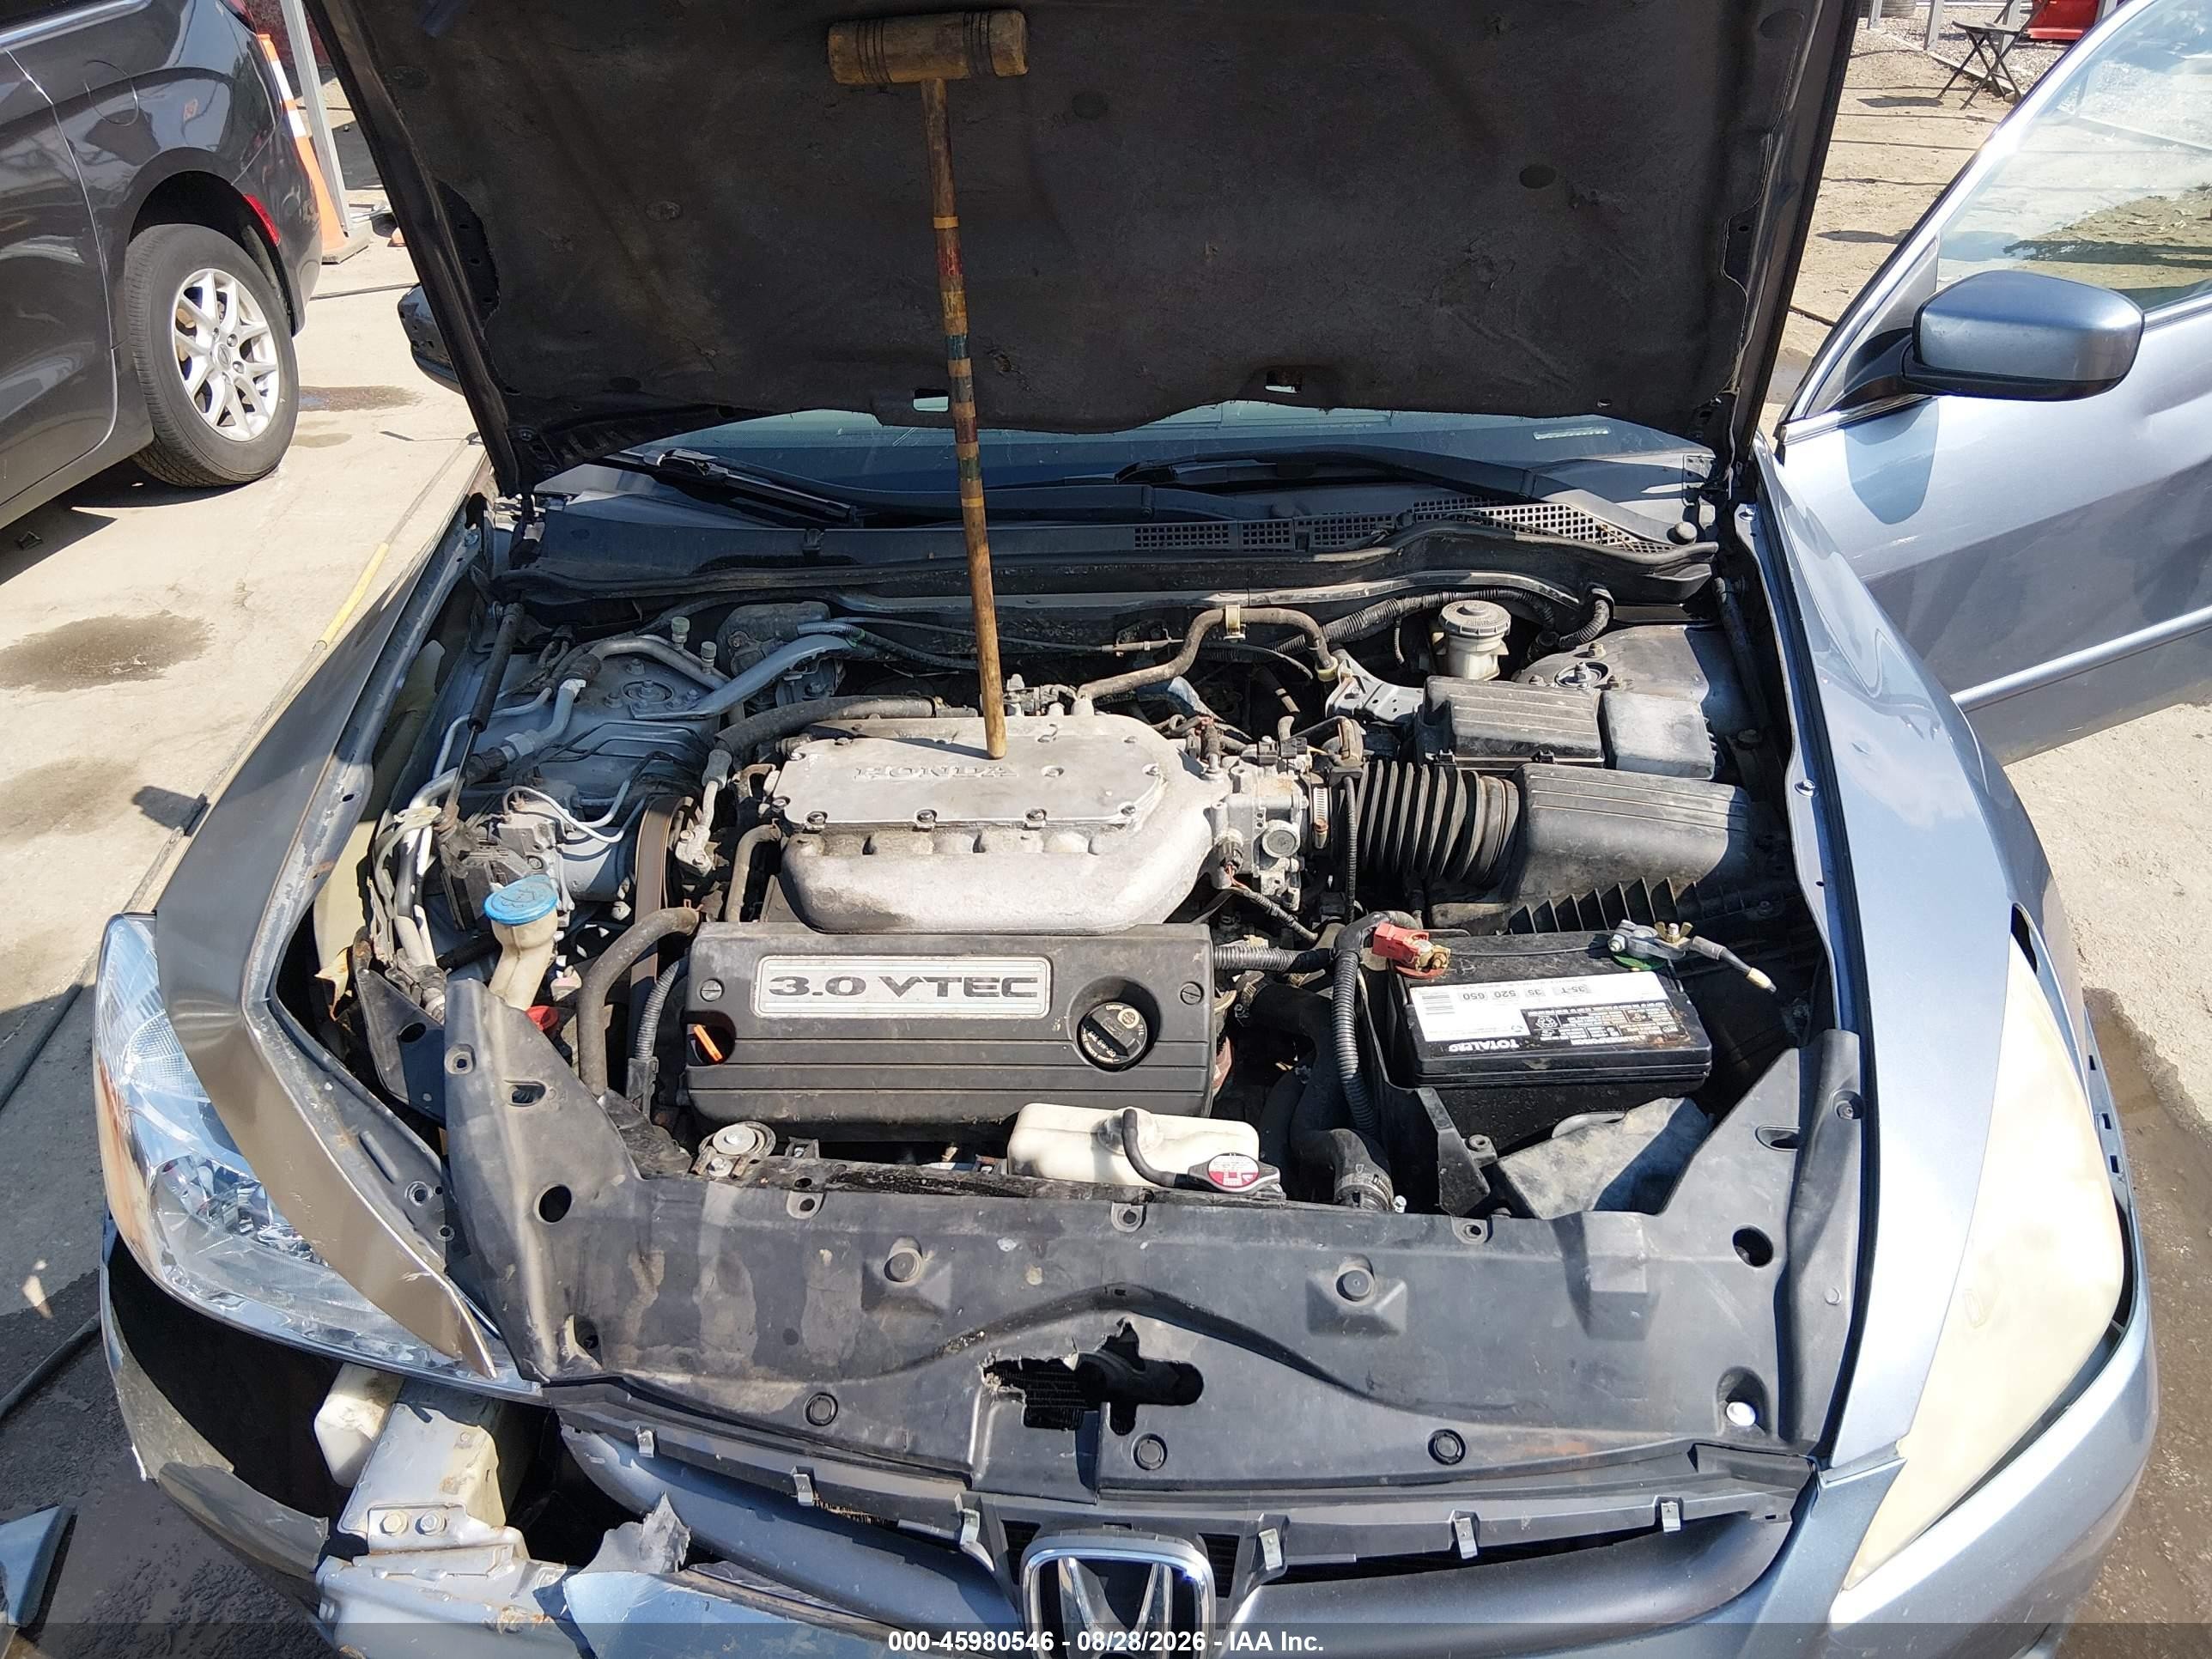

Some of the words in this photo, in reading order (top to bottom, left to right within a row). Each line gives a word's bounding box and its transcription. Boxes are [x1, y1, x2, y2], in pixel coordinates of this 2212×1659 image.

[854, 766, 1018, 780] HONDA
[769, 975, 866, 996] 3.0
[878, 975, 1038, 998] VTEC
[1494, 989, 1517, 999] 520
